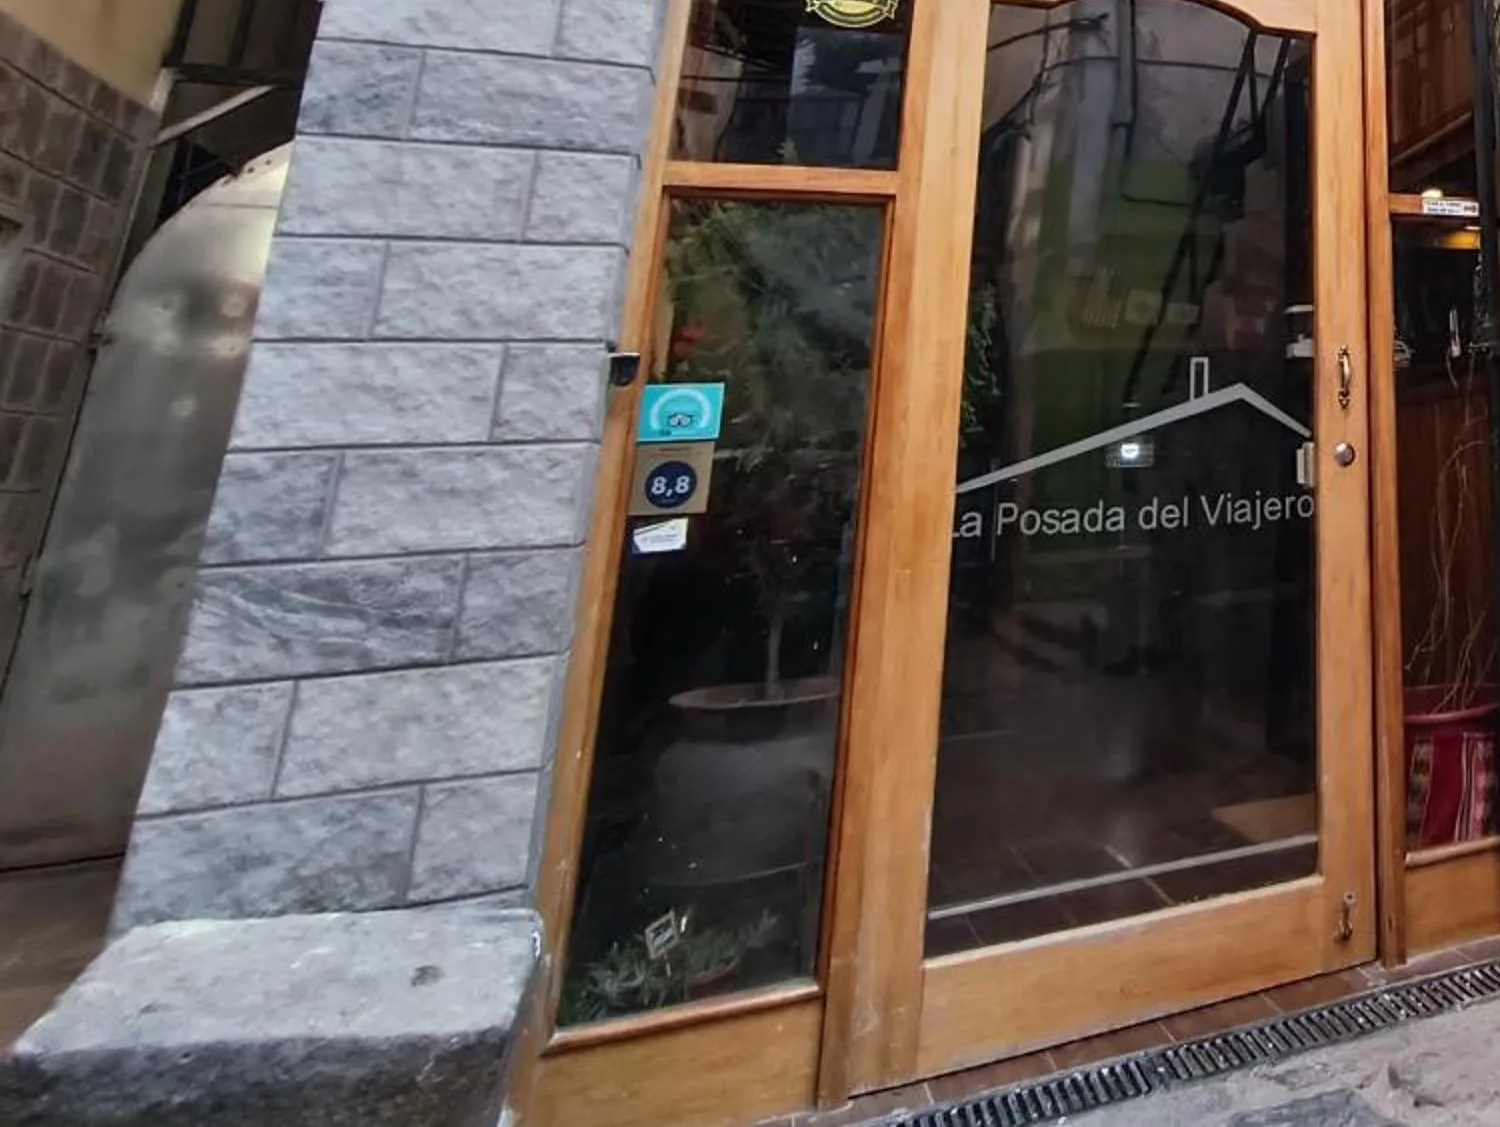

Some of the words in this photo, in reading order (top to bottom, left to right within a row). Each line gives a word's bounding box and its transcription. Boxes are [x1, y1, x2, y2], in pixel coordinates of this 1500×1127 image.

[650, 474, 691, 498] 8,8
[952, 510, 983, 538] a
[996, 498, 1126, 536] Posada
[1138, 495, 1189, 530] del
[1199, 489, 1315, 531] Viajero
